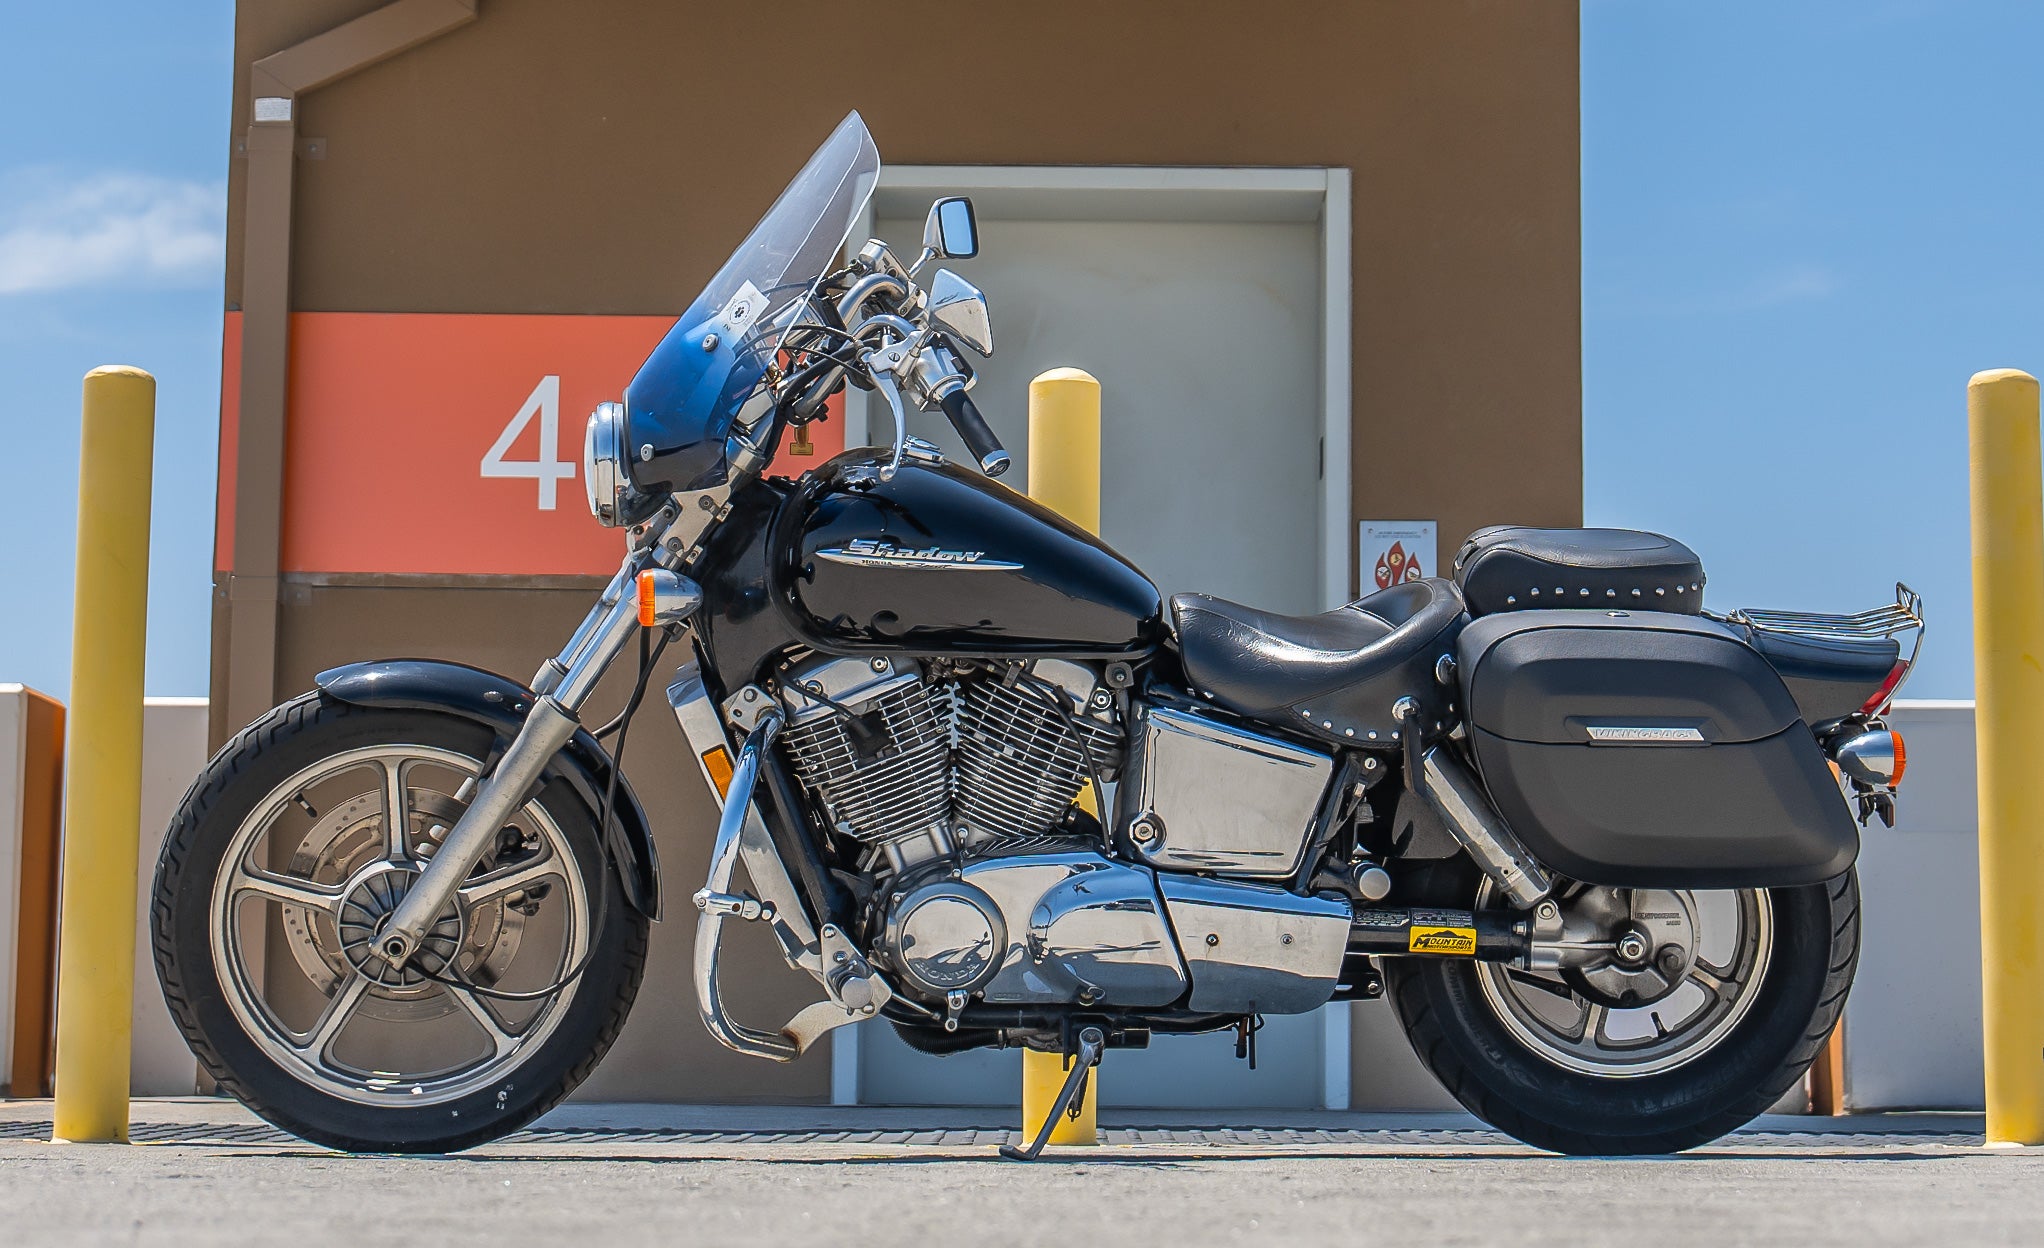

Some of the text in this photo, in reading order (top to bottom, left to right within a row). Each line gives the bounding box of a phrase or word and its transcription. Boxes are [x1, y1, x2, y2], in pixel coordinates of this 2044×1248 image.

[480, 375, 576, 511] 4
[842, 538, 985, 562] Shadow
[1413, 937, 1473, 948] MOUNTAIN
[914, 962, 980, 981] HONDA
